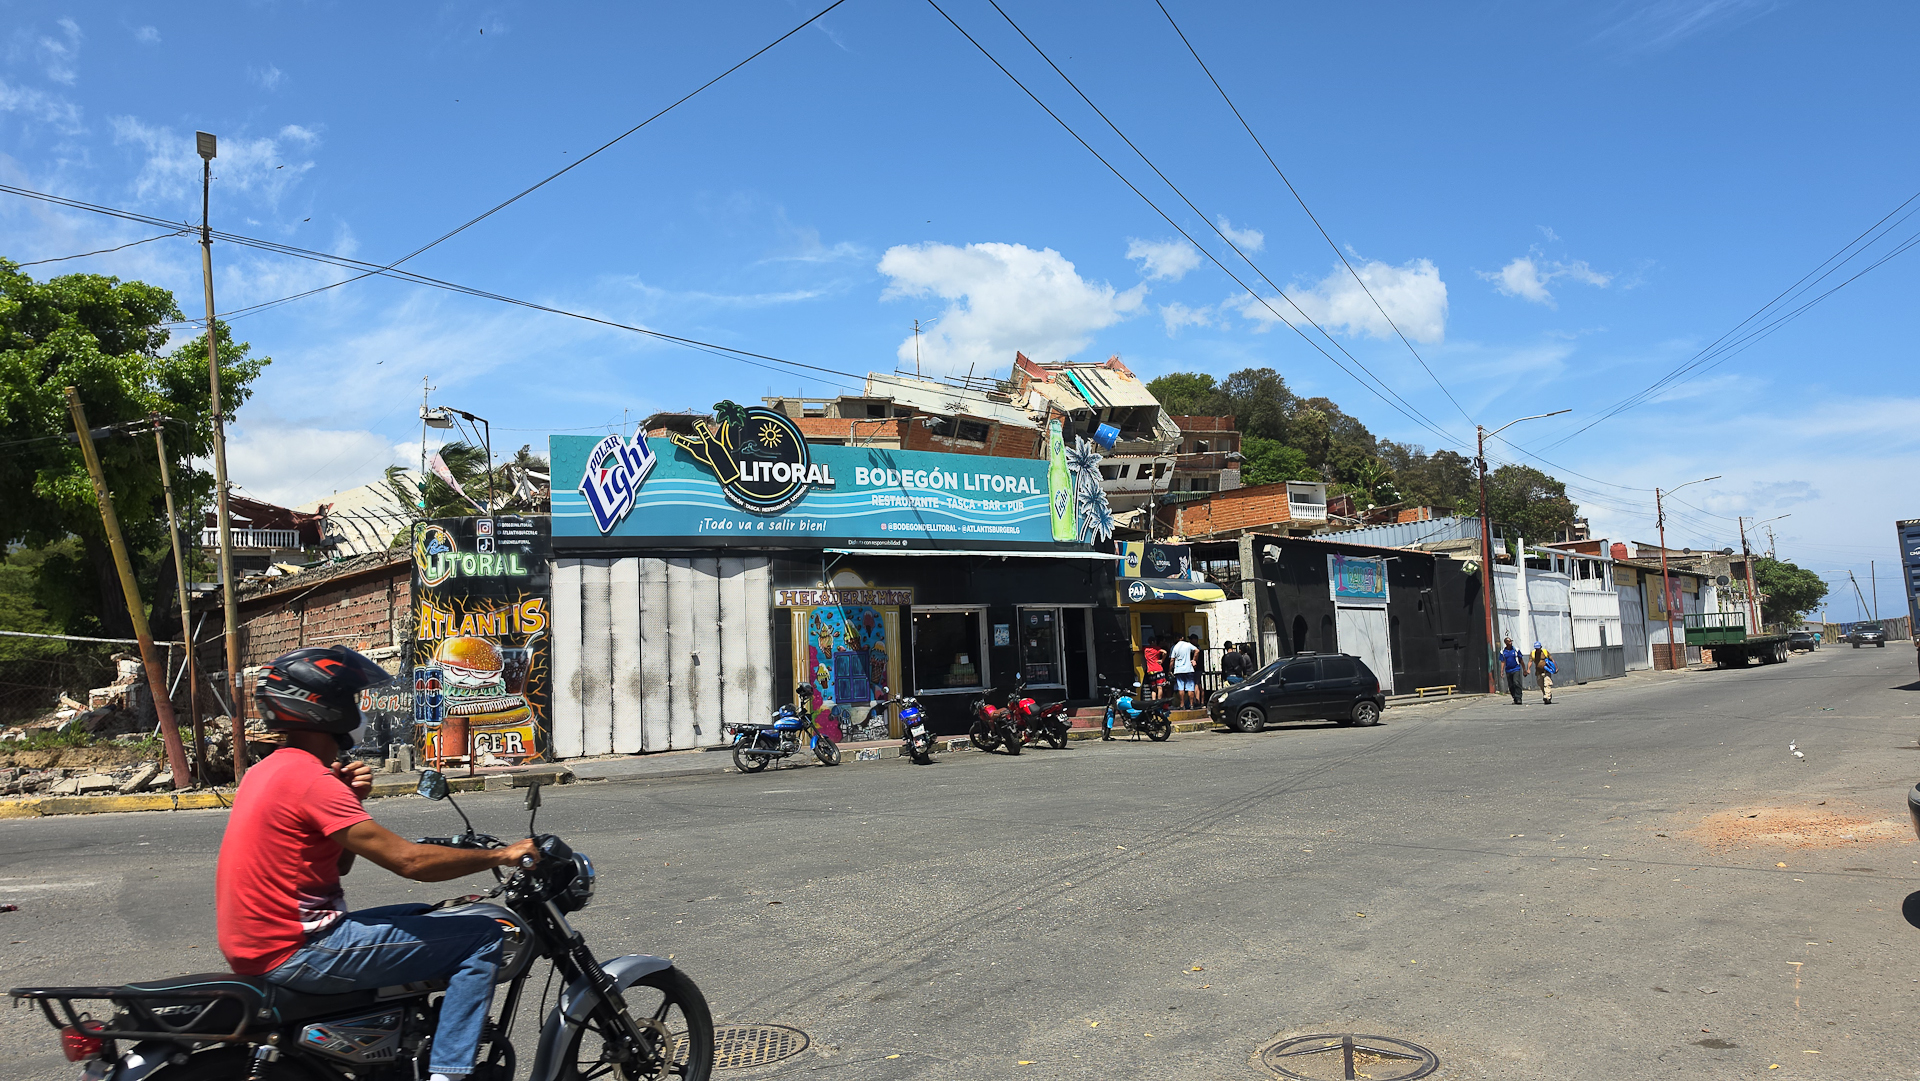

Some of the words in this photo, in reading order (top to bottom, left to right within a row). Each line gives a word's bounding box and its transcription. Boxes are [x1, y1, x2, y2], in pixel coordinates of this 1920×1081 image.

[590, 436, 621, 476] POLAR
[582, 432, 656, 531] Light
[740, 461, 835, 484] LITORAL
[855, 466, 958, 490] BODEGÓN
[964, 473, 1040, 494] LITORAL
[871, 495, 939, 509] RESTAURANTE
[946, 497, 976, 511] TASCA
[982, 499, 1001, 511] BAR
[1007, 501, 1024, 512] PUB
[699, 517, 733, 532] ¡Todo
[738, 520, 752, 531] va
[756, 521, 764, 531] a
[768, 518, 796, 531] salir
[799, 519, 827, 532] bien!
[427, 551, 528, 579] LITORAL
[1127, 555, 1139, 564] PAN
[780, 591, 877, 606] HELADERIA
[1128, 586, 1146, 597] PAN
[418, 598, 546, 641] ATLANTIS
